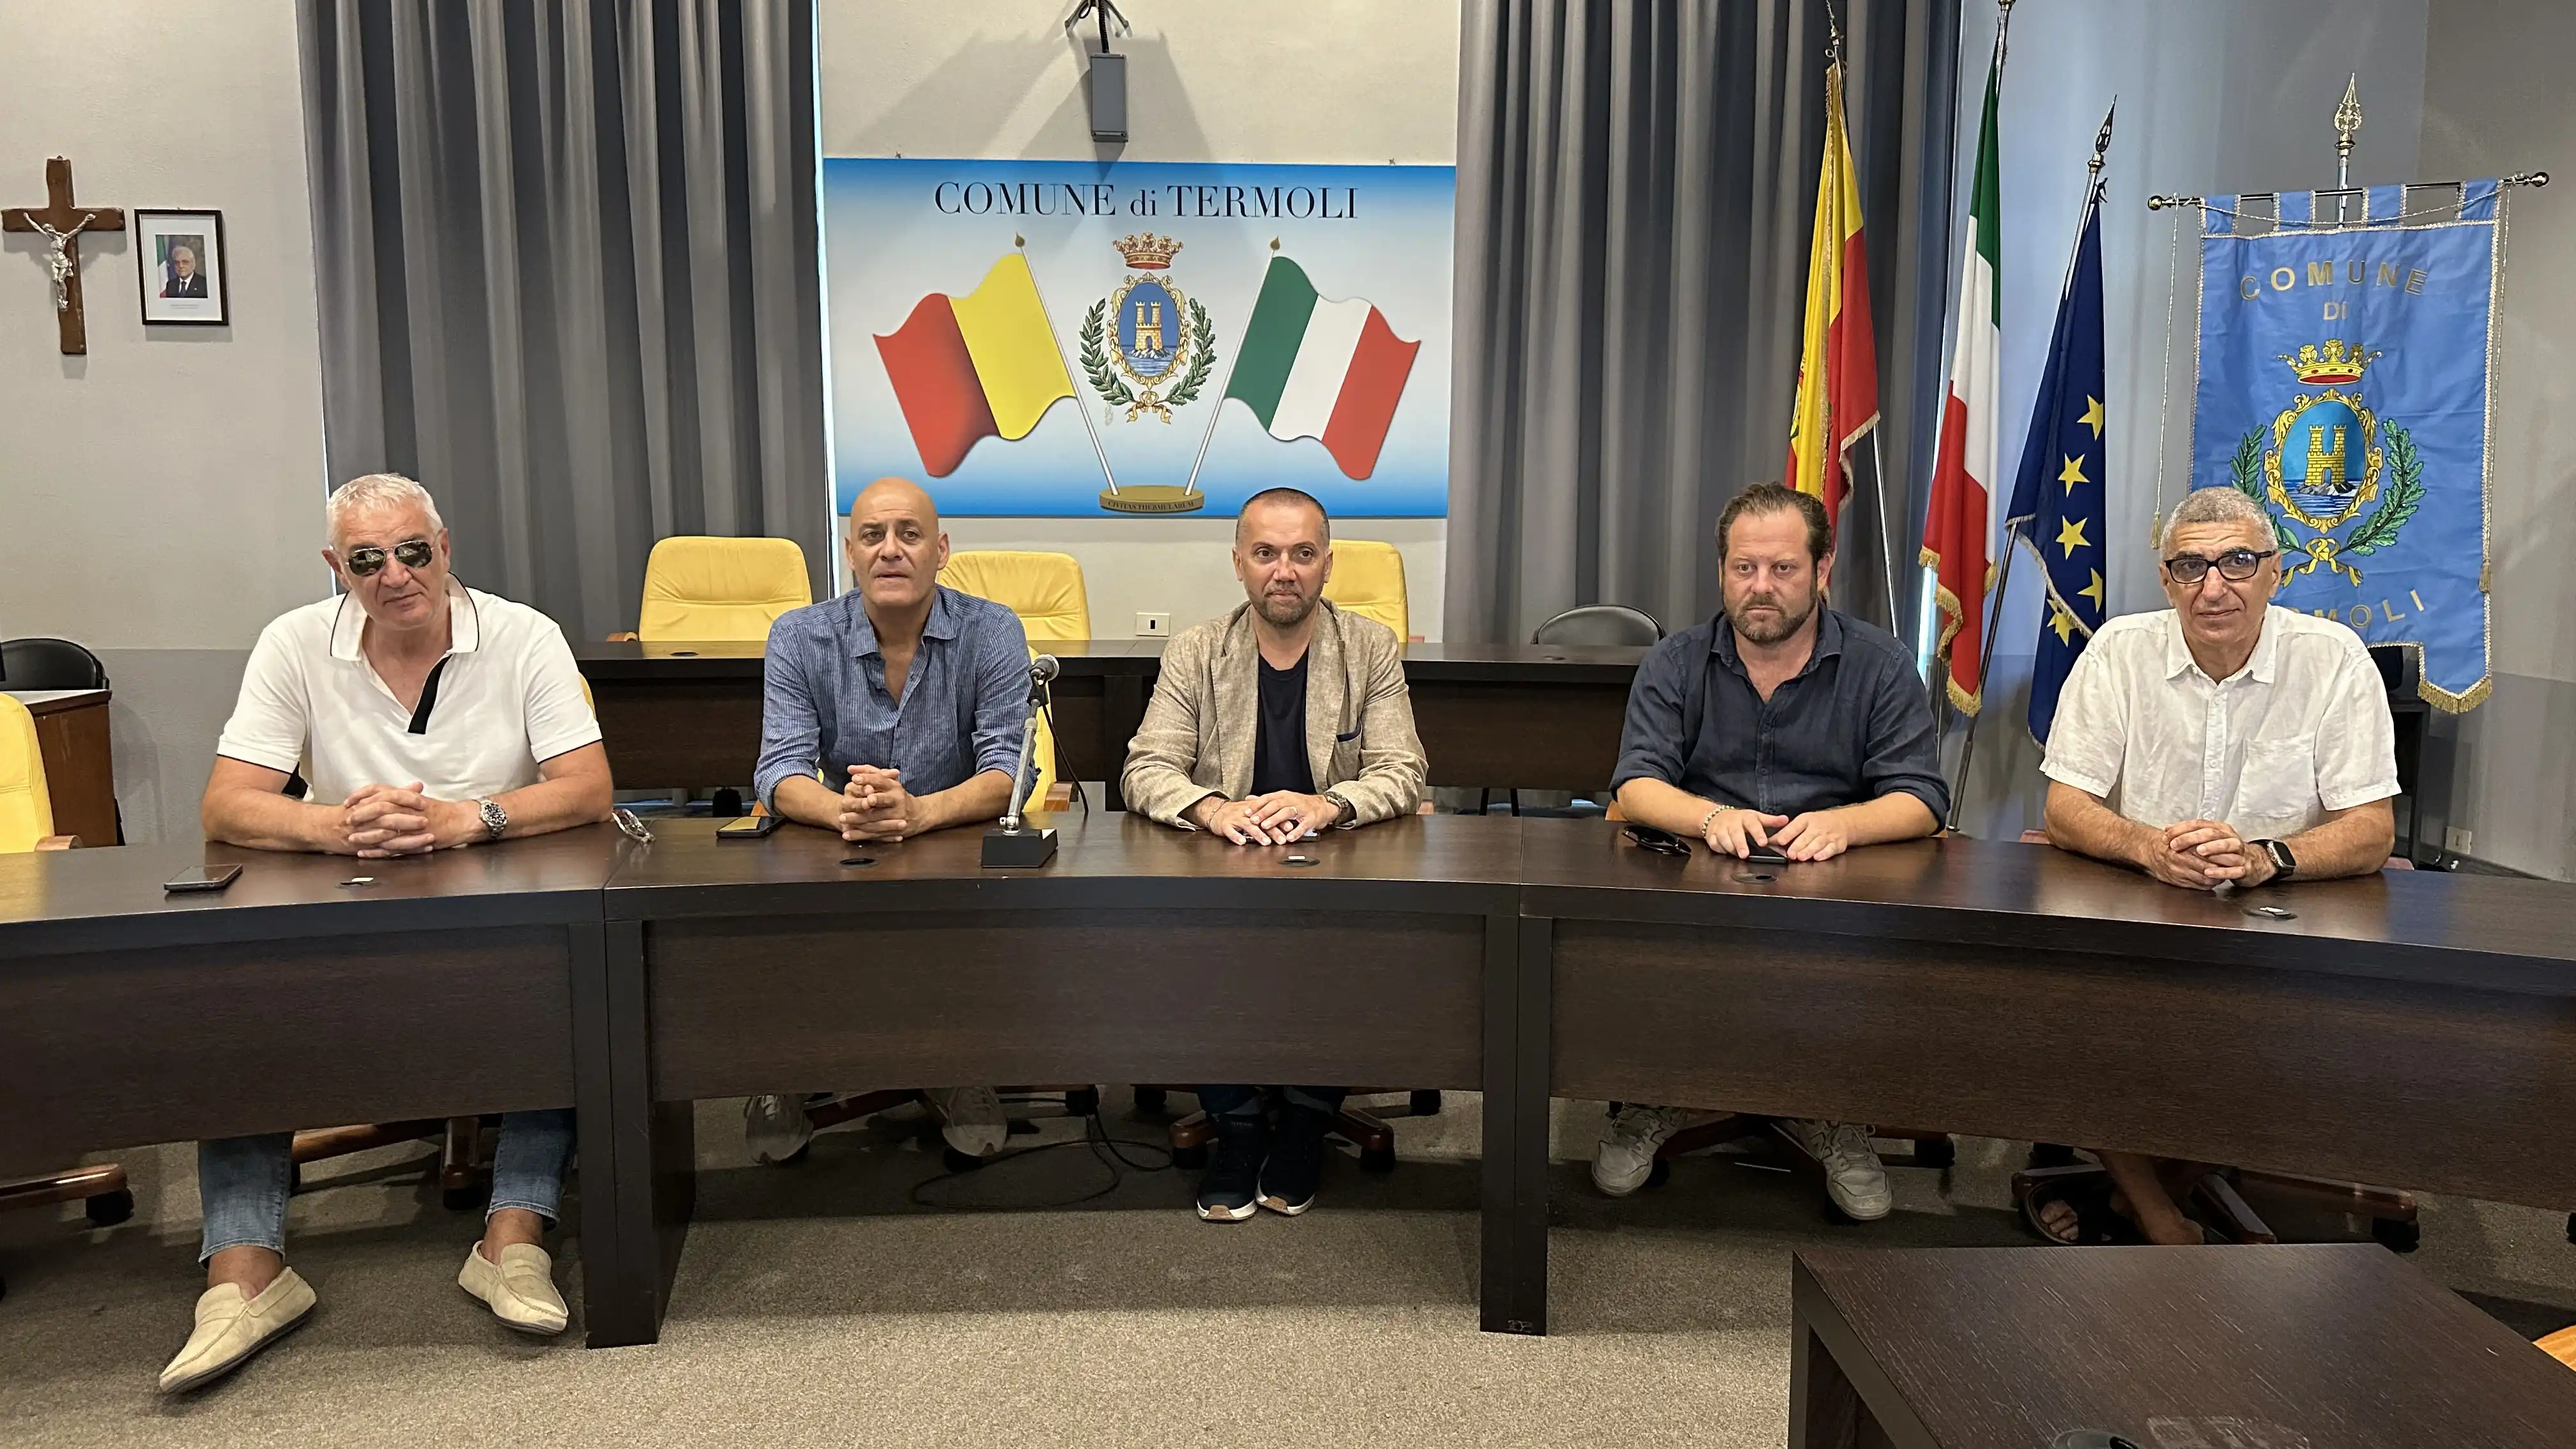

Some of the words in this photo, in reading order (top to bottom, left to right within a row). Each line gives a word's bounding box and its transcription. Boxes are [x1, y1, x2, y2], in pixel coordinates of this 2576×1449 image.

[935, 181, 1116, 217] COMUNE
[1130, 189, 1156, 218] di
[1167, 185, 1359, 219] TERMOLI
[2240, 260, 2428, 300] COMUNE
[2323, 302, 2348, 321] DI
